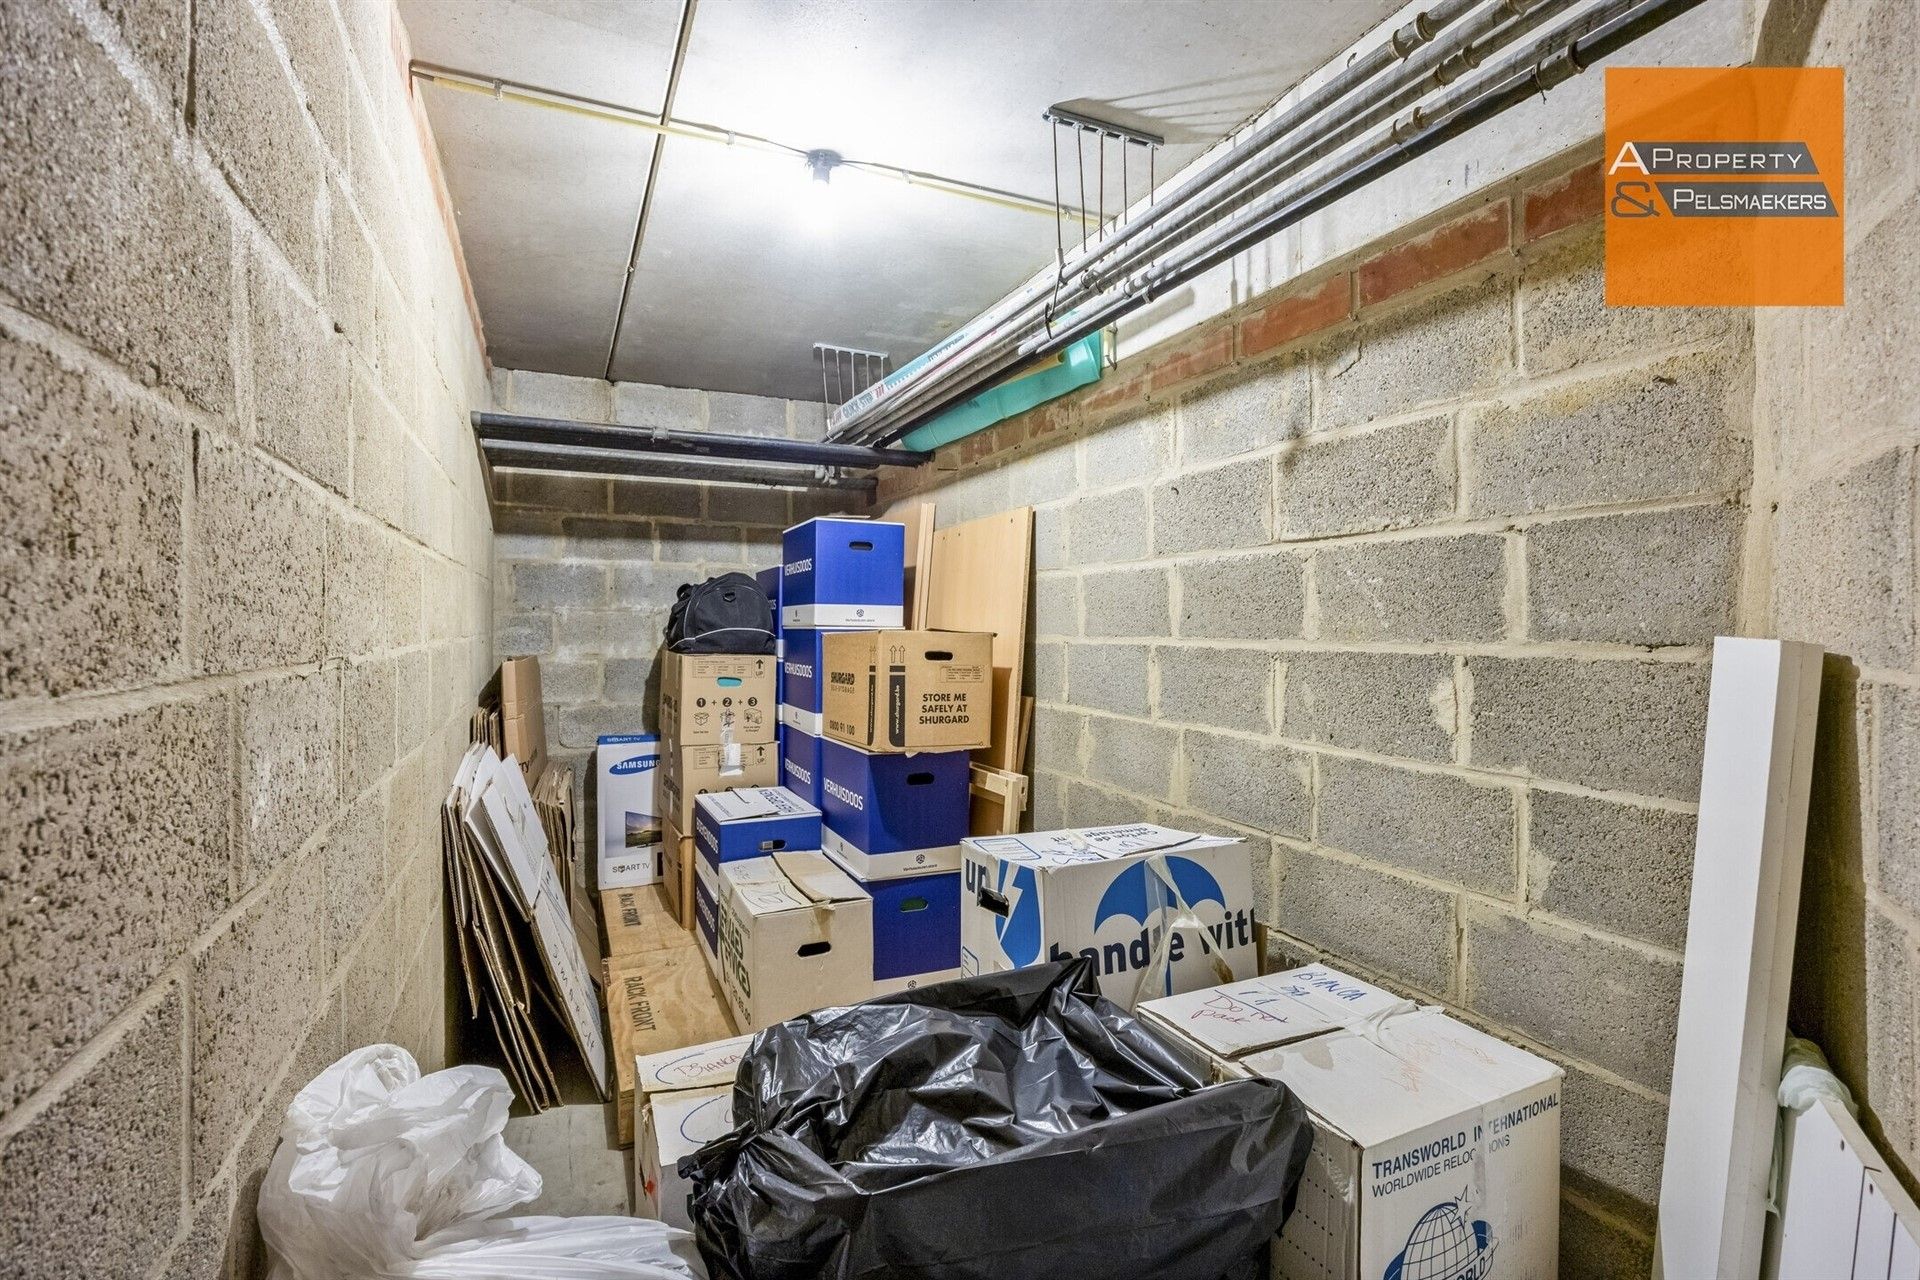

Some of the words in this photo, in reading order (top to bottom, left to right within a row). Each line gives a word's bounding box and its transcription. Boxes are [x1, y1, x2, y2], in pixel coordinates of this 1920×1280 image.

[784, 662, 813, 678] VERHUISDOOS
[830, 671, 855, 686] SHURGARD
[922, 693, 951, 702] STORE
[953, 693, 967, 702] ME
[921, 704, 954, 714] SAFELY
[956, 704, 968, 713] AT
[919, 715, 970, 725] SHURGARD
[823, 777, 864, 811] VERHUISDOOS
[613, 864, 640, 873] SMART
[621, 908, 642, 927] FRONT
[623, 975, 647, 1001] RACK
[629, 999, 656, 1032] FRONT
[1372, 1131, 1466, 1179] TRANSWORLD
[1371, 1161, 1441, 1198] WORLDWIDE
[1443, 1134, 1511, 1172] RELOCIONS
